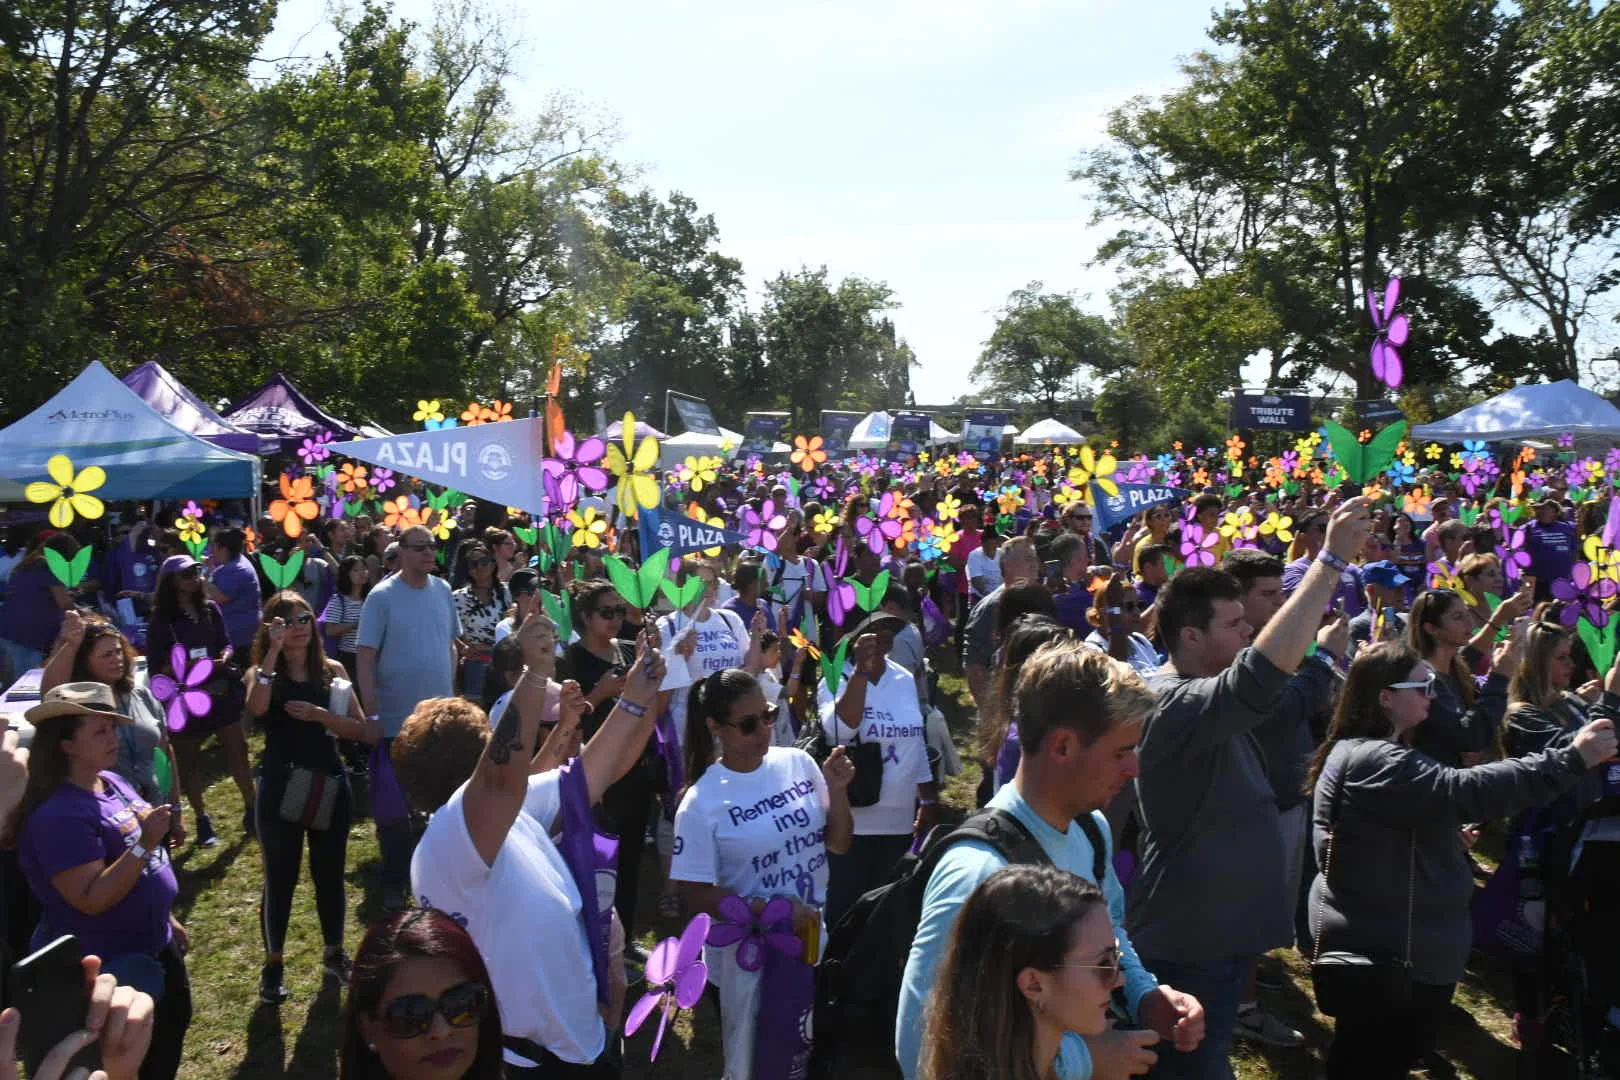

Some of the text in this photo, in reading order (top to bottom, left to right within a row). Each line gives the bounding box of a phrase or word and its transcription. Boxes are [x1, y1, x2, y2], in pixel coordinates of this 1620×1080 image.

[1250, 407, 1294, 416] TRIBUTE
[1258, 416, 1287, 425] WALL
[1129, 488, 1174, 507] PLAZA
[678, 524, 725, 547] PLAZA
[696, 643, 717, 653] are
[771, 807, 810, 833] ing
[752, 849, 781, 874] for
[807, 852, 827, 873] ca
